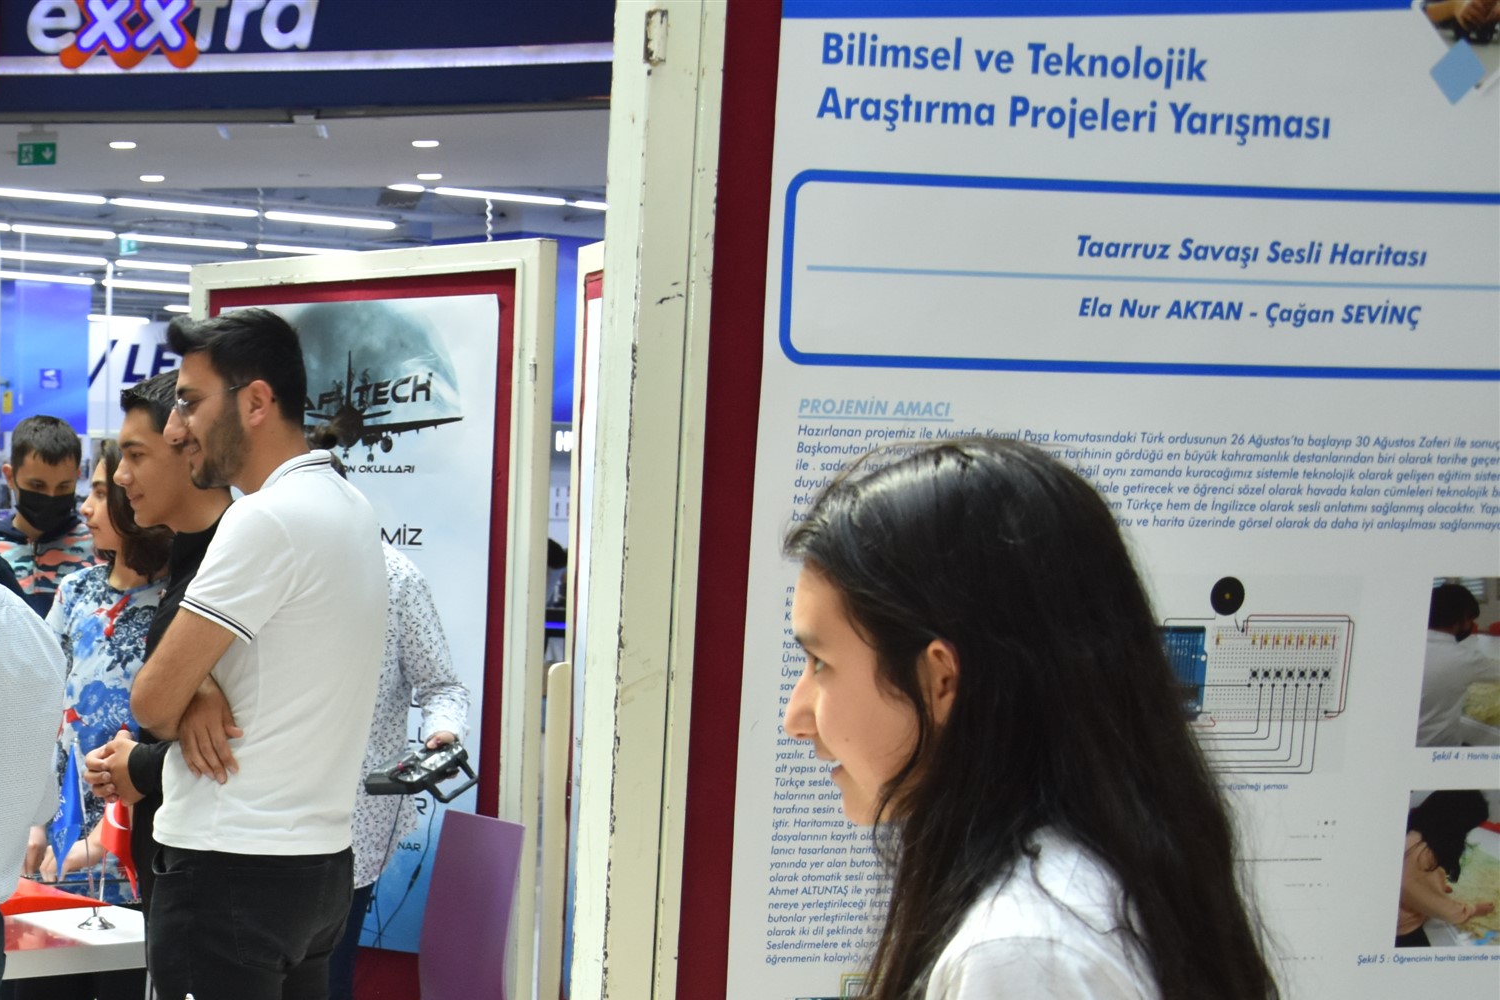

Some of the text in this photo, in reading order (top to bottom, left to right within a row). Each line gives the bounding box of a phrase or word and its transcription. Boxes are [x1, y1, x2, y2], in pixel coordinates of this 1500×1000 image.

[821, 33, 1207, 89] Bilimsel ve Teknolojik
[817, 88, 1330, 145] Araştırma Projeleri Yarışması
[1076, 236, 1427, 269] Taarruz Savaşı Sesli Haritası
[1078, 298, 1111, 318] Ela
[1119, 299, 1159, 320] Nur
[1167, 301, 1242, 321] AKTAN
[1266, 300, 1334, 327] Çağan
[1341, 299, 1421, 330] SEVİNÇ
[799, 397, 950, 416] PROJENİN AMACI
[798, 425, 861, 437] Hazırlanan
[865, 427, 915, 440] projemiz
[920, 428, 932, 438] ile
[1024, 430, 1049, 443] Paşa
[1053, 430, 1136, 443] komutasındaki
[1141, 432, 1164, 443] Türk
[1168, 432, 1226, 445] ordusunun
[1231, 434, 1245, 445] 26
[1308, 435, 1352, 450] başlayıp
[1356, 436, 1370, 447] 30
[1373, 436, 1415, 449] Ağustos
[1419, 436, 1450, 448] Zaferi
[1065, 450, 1111, 459] tarihinin
[1116, 450, 1163, 462] gördüğü
[1184, 451, 1217, 464] büyük
[1221, 451, 1289, 462] kahramanlık
[1293, 451, 1373, 464] destanlarından
[1437, 454, 1467, 464] tarihe
[358, 465, 415, 474] OKULLARI
[796, 459, 808, 470] ile
[1103, 468, 1126, 478] aynı
[1130, 466, 1182, 478] zamanda
[1186, 467, 1252, 480] kuracağımız
[1256, 468, 1300, 479] sistemle
[1303, 470, 1354, 482] teknolojik
[1396, 470, 1434, 482] gelişen
[1438, 470, 1471, 483] eğitim
[1123, 483, 1173, 496] getirecek
[1193, 484, 1234, 496] öğrenci
[1238, 484, 1265, 495] sözel
[1307, 485, 1346, 496] havada
[1351, 486, 1380, 496] kalan
[1384, 486, 1433, 497] cümleleri
[1436, 486, 1488, 499] teknolojik
[1127, 499, 1162, 512] Türkçe
[1166, 499, 1190, 510] hem
[1211, 499, 1256, 513] İngilizce
[1298, 501, 1319, 512] sesli
[1324, 502, 1367, 512] anlatımı
[1371, 502, 1424, 515] sağlanmış
[1153, 516, 1435, 532] harita üzerinde görsel daha anlaşılması
[775, 750, 804, 761] yazılır.
[1432, 752, 1459, 762] Şekil 4
[775, 764, 816, 775] alt yapısı
[775, 778, 805, 788] Türkçe
[774, 791, 815, 800] halarının
[773, 805, 835, 814] tarafına sesin
[793, 819, 844, 827] Haritamıza
[772, 832, 857, 842] dosyalarının kayıtlı
[771, 845, 846, 855] lanıcı tasarlanan
[770, 859, 846, 870] yanında alan
[770, 872, 841, 882] olarak otomatik
[768, 886, 848, 896] Ahmet ALTUNTAŞ
[768, 899, 866, 910] nereye yerleştirileceği
[768, 912, 868, 924] butonlar yerleştirilerek
[767, 926, 863, 937] olarak şeklinde
[766, 940, 838, 950] Seslendirmelere
[766, 954, 820, 965] öğrenmenin
[1357, 955, 1375, 966] Şekil
[1378, 955, 1385, 963] 5
[1393, 955, 1432, 964] Öğrencinin
